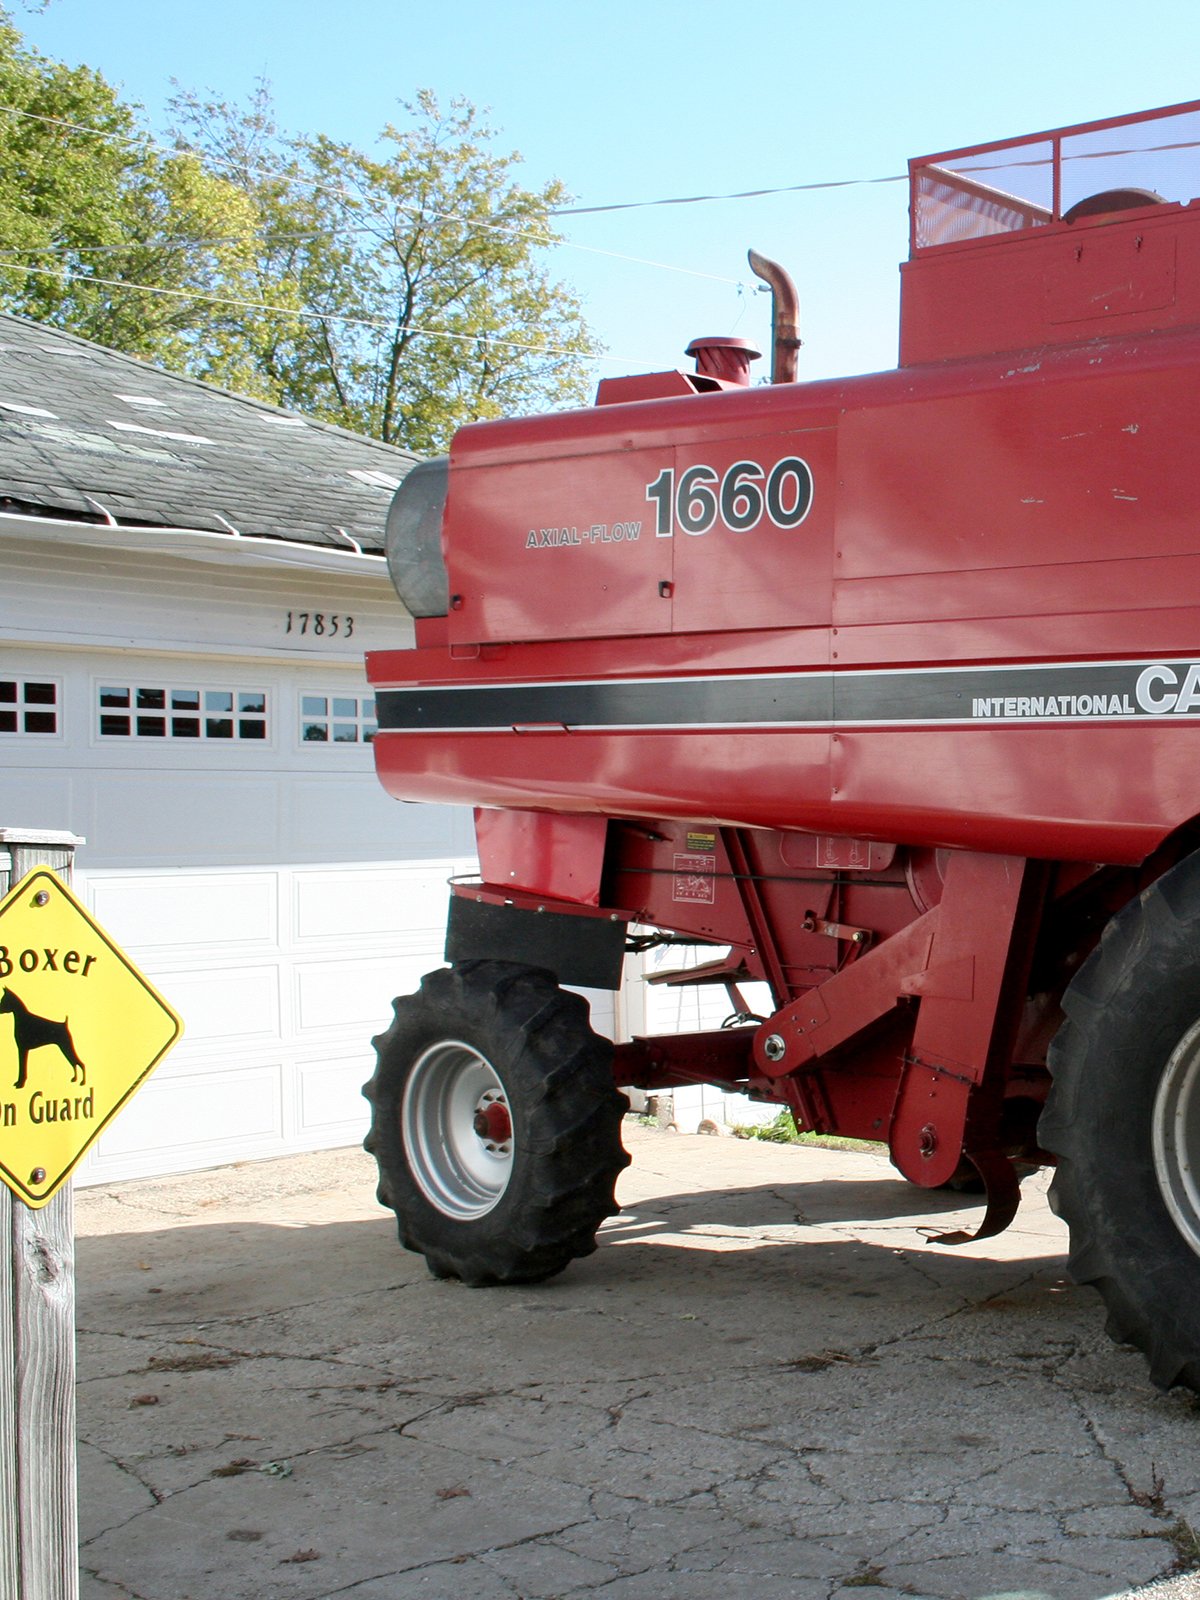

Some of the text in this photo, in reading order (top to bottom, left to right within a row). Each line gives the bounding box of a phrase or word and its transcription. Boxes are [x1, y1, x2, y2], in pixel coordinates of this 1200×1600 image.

[646, 456, 814, 538] 1660
[525, 521, 641, 549] AXIAL-FLOW
[286, 611, 354, 638] 17853
[972, 694, 1135, 717] INTERNATIONAL
[0, 945, 97, 979] Boxer
[0, 1087, 94, 1127] n Guard
